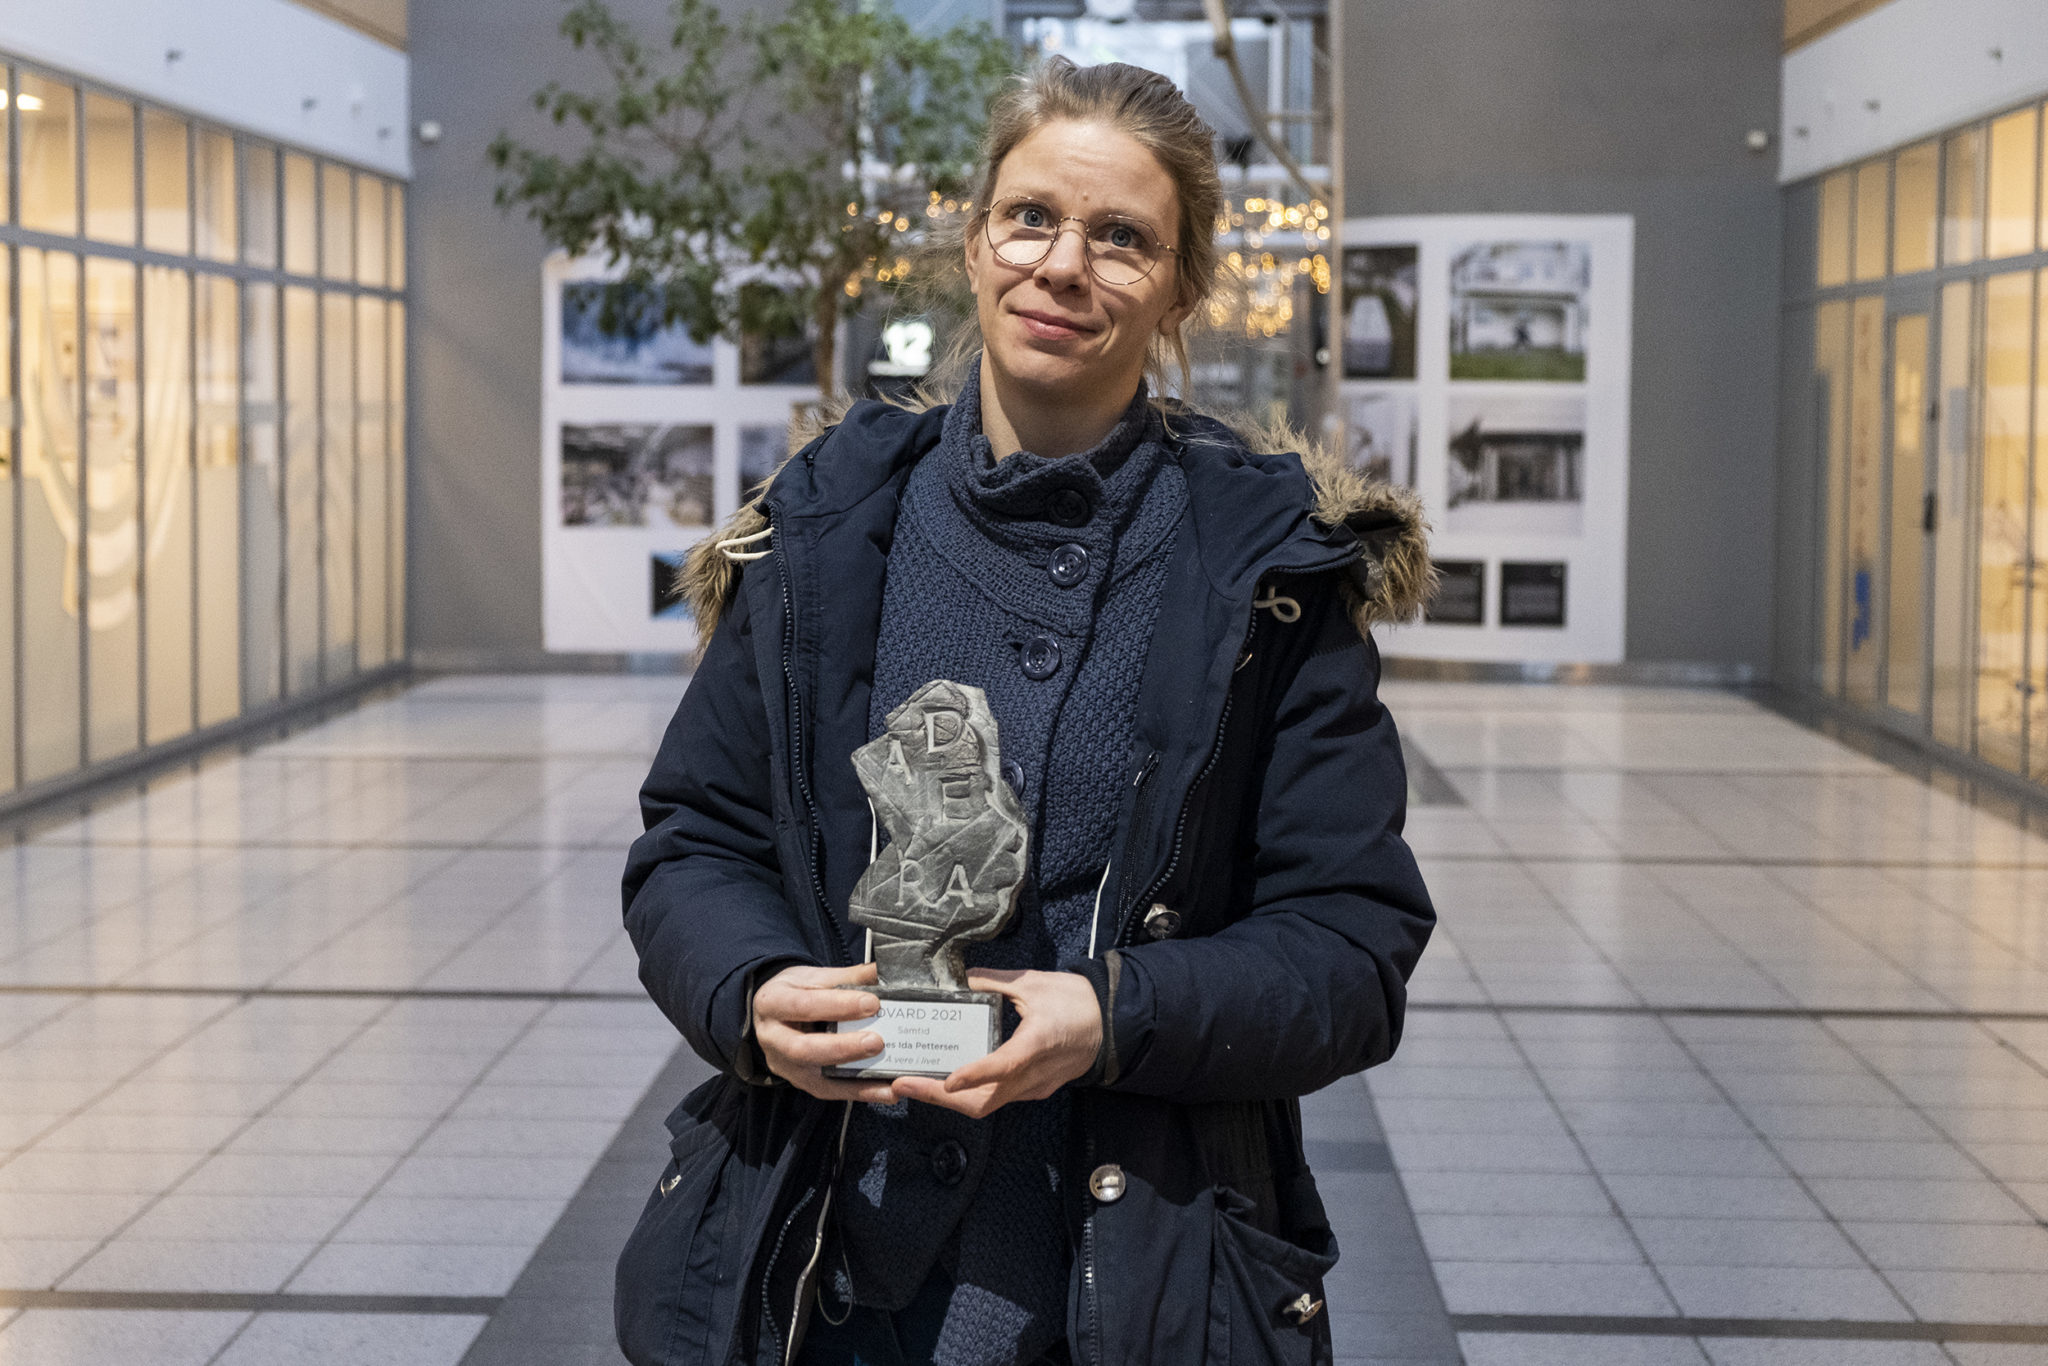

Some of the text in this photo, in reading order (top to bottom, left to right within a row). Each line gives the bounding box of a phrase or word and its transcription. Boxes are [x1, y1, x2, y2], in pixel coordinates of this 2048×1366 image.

[876, 1007, 962, 1021] DVARD 2021
[898, 1041, 913, 1049] Ida
[915, 1042, 959, 1051] Pettersen
